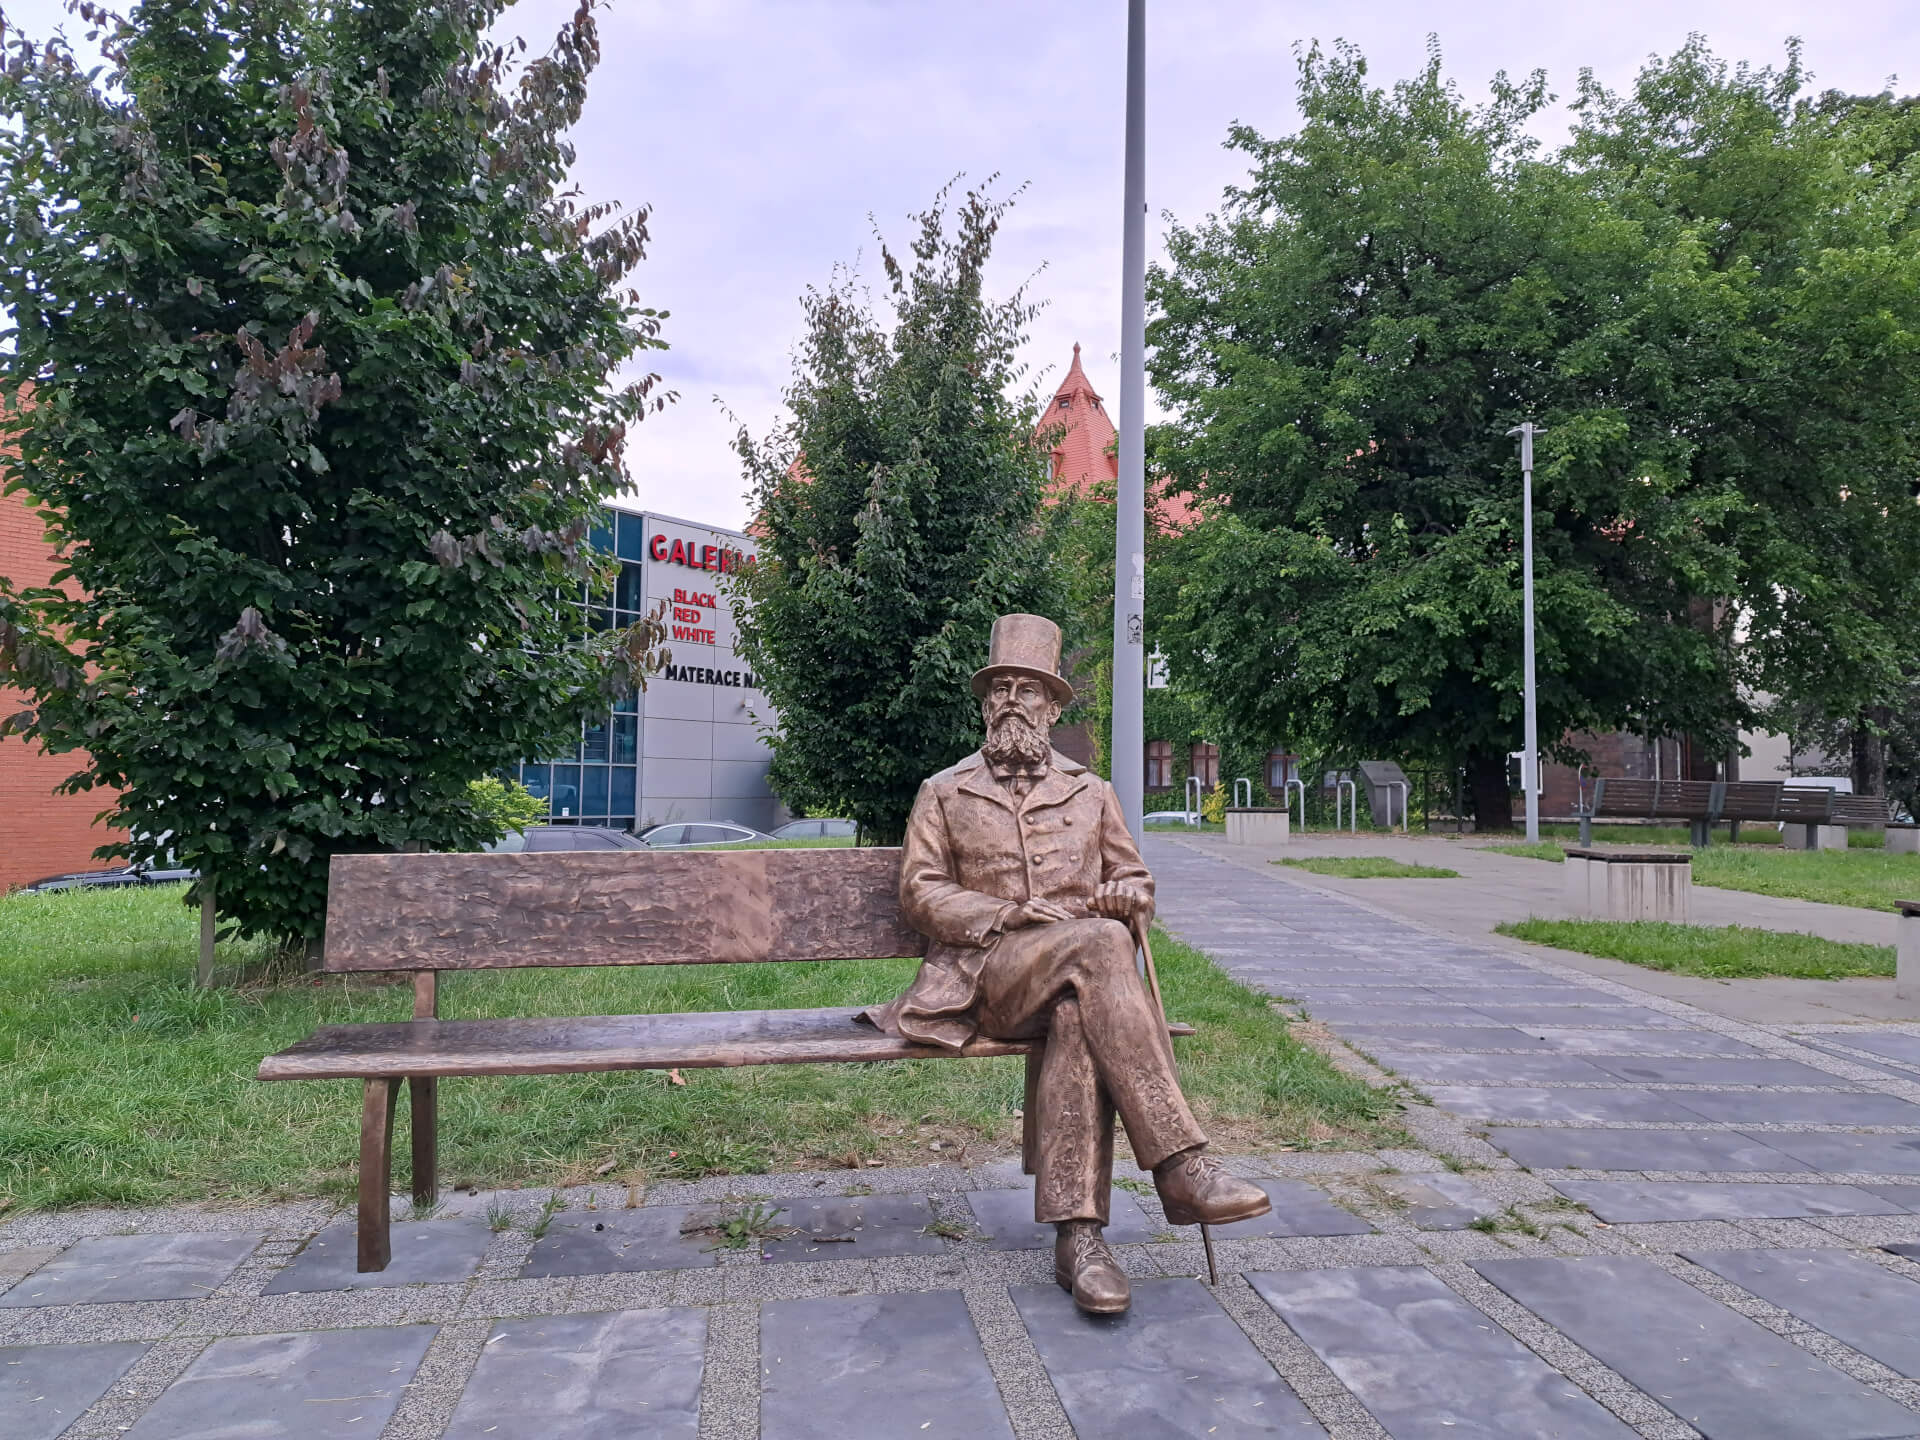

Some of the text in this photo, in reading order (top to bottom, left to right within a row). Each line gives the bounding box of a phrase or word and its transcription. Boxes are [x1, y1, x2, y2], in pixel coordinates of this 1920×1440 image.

[674, 588, 717, 608] BLACK
[673, 607, 701, 624] RED
[672, 625, 716, 644] WHITE
[665, 664, 741, 687] MATERACE
